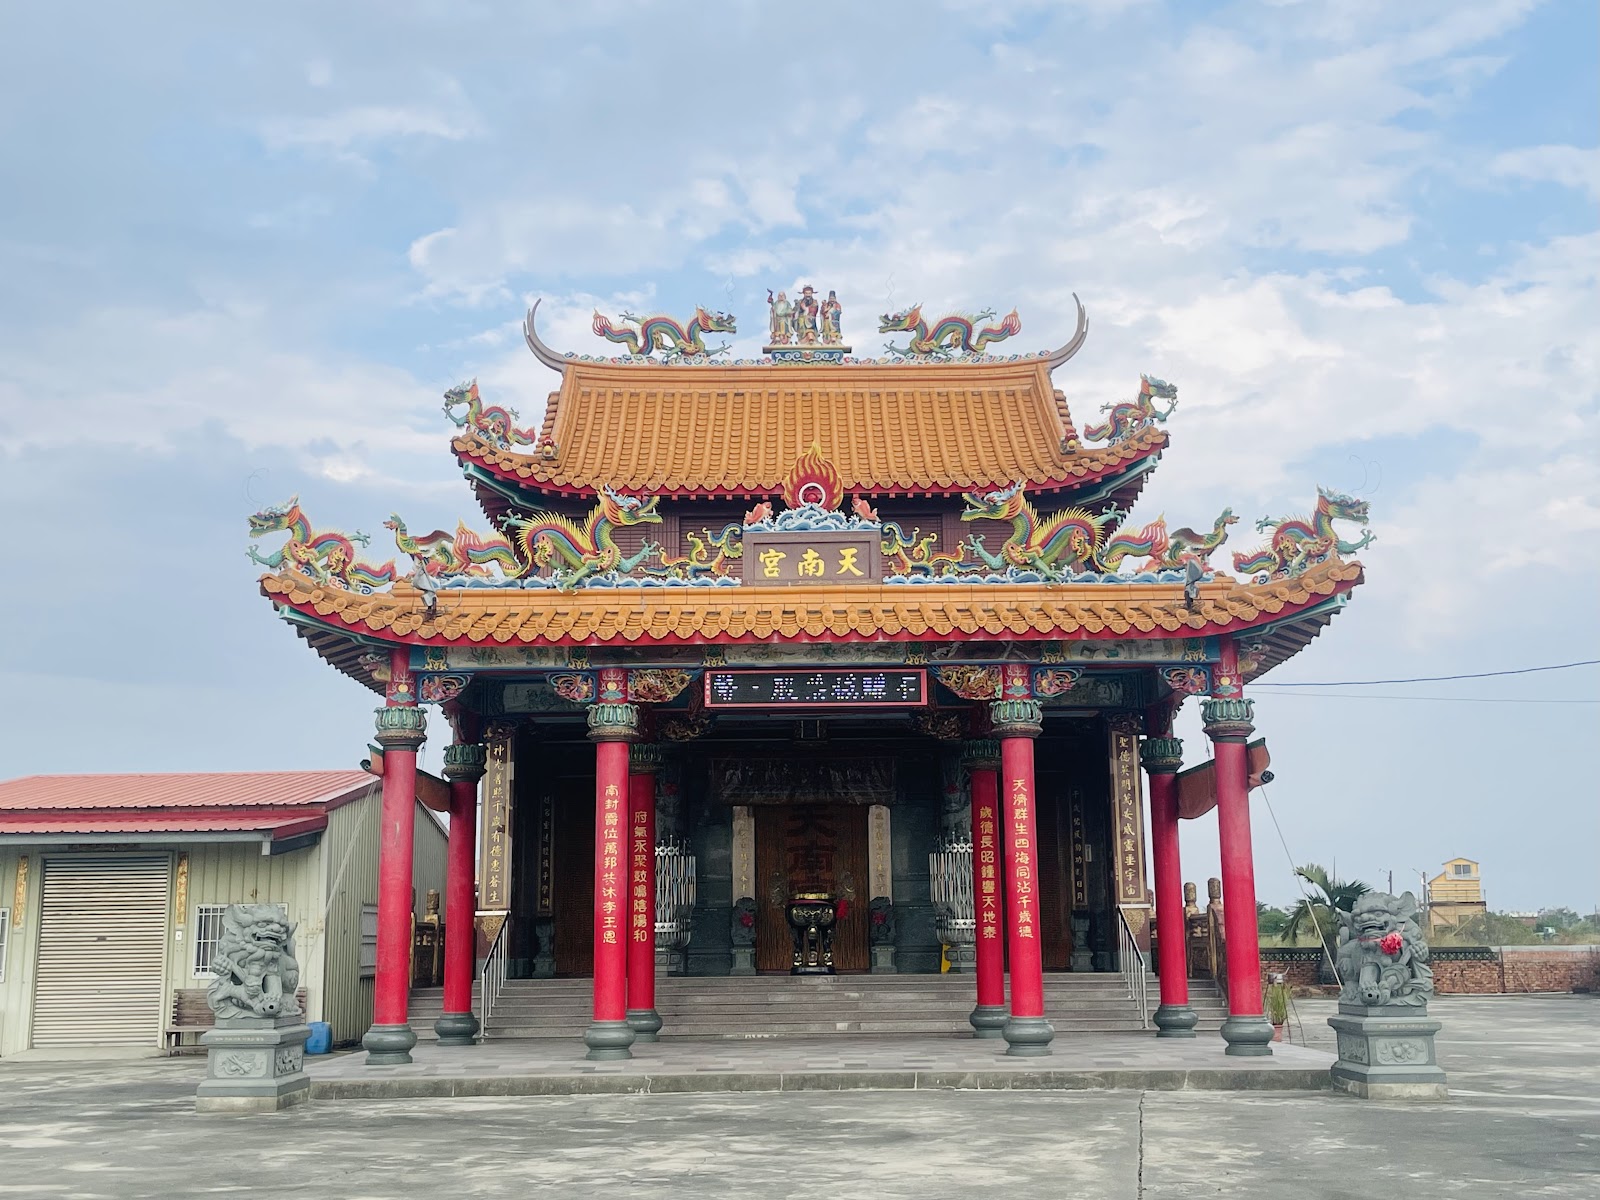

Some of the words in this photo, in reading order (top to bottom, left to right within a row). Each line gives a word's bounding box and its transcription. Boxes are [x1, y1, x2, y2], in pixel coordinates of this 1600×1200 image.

[758, 547, 865, 578] 天南宮
[602, 784, 619, 944] 南封爵位萬邦共沐李王恩
[1012, 779, 1034, 938] 天濟群生四海同沾千歲德
